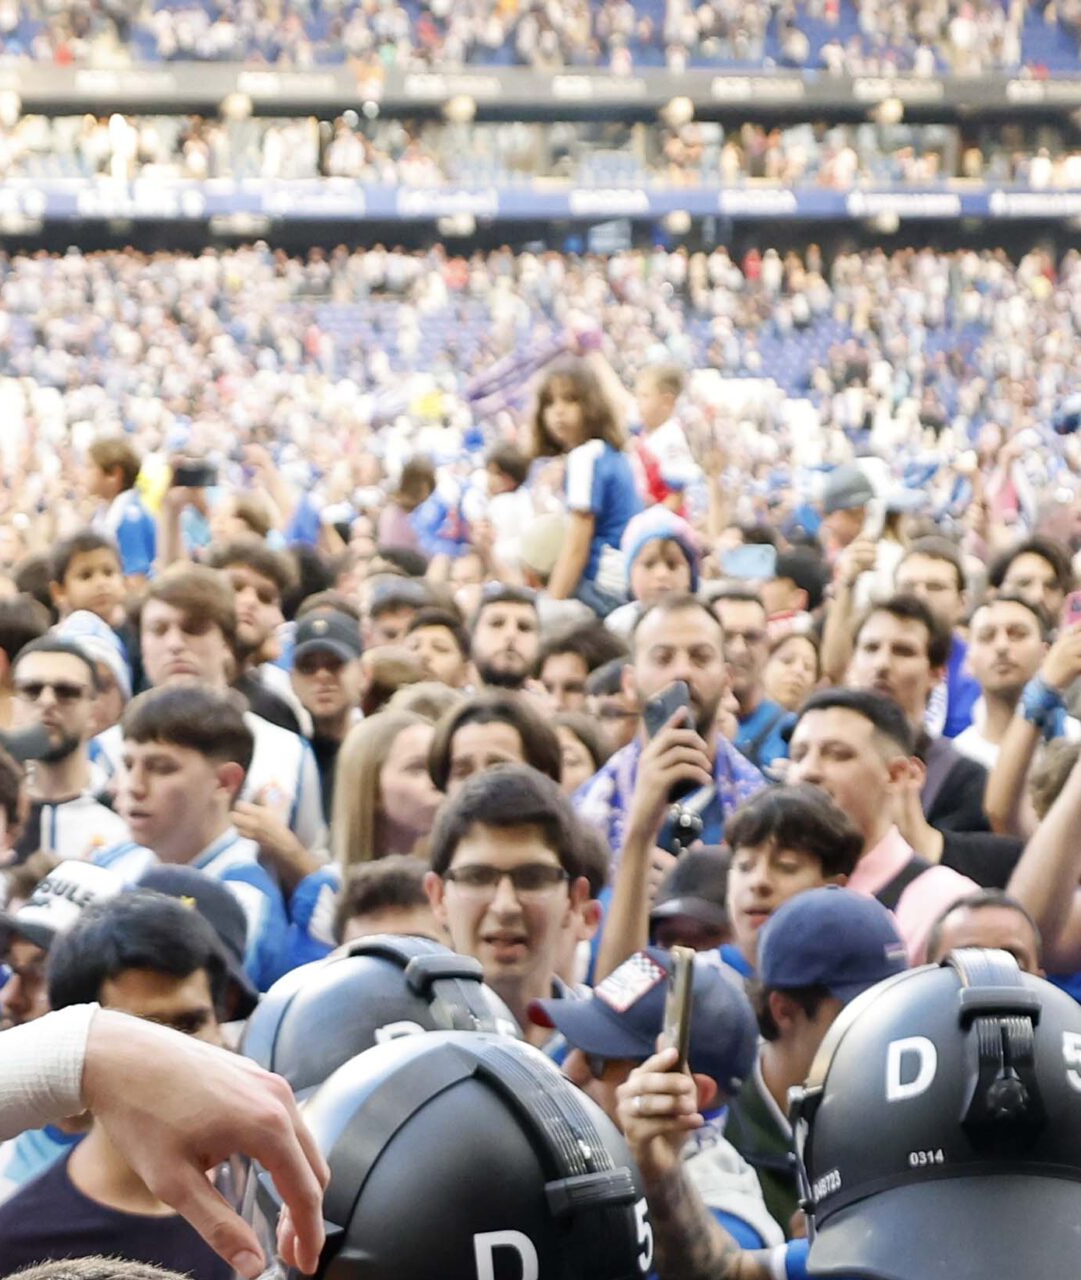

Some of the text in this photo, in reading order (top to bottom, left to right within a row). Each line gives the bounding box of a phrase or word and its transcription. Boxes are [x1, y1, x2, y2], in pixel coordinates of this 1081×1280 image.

[886, 1036, 937, 1102] D
[909, 1149, 945, 1168] 0314
[633, 1197, 654, 1272] 5
